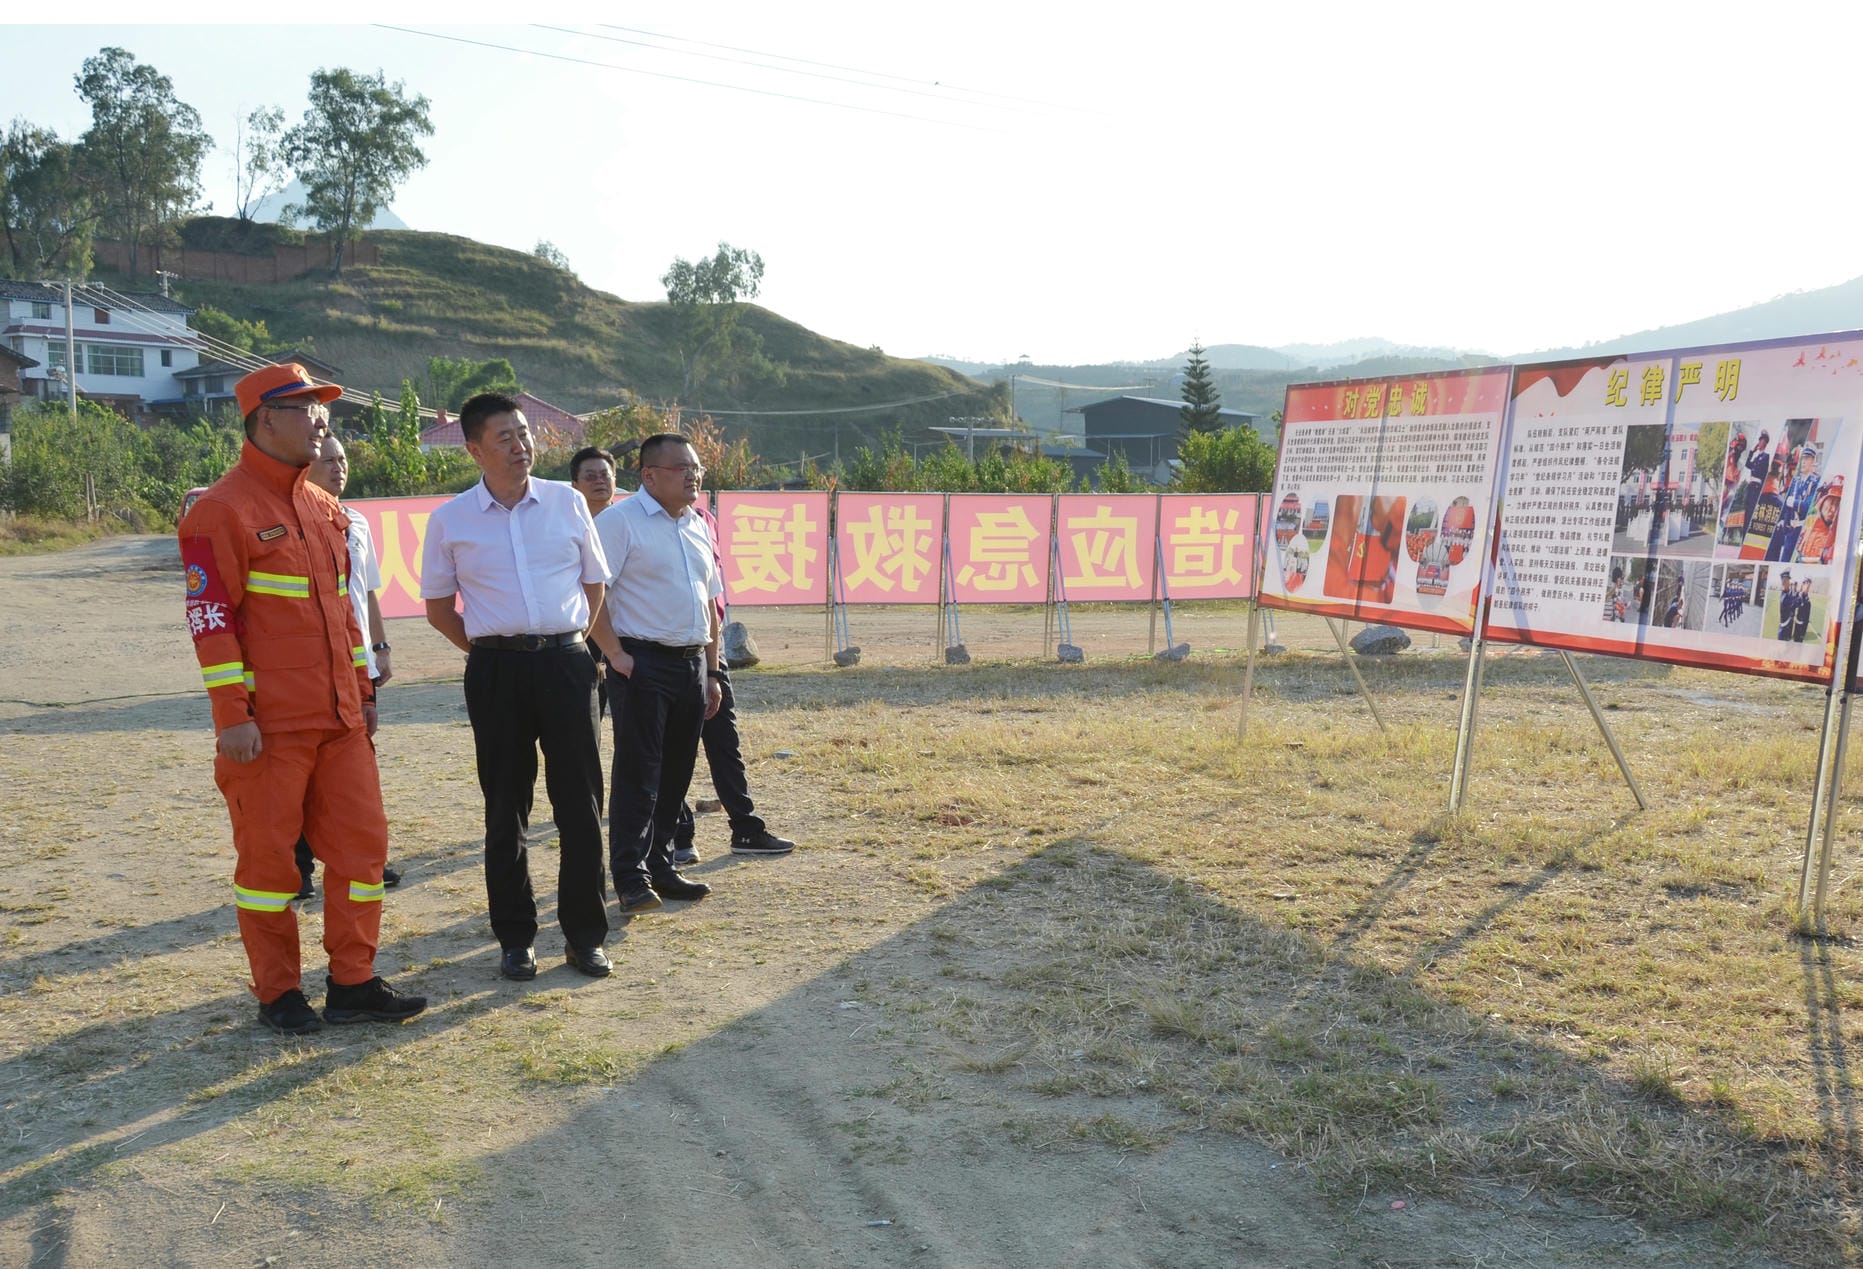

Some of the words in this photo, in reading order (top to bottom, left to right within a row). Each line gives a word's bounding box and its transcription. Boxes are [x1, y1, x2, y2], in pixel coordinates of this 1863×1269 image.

[1344, 382, 1428, 418] 对党忠诚
[1605, 359, 1741, 406] 纪律严明
[187, 604, 226, 635] 挥长
